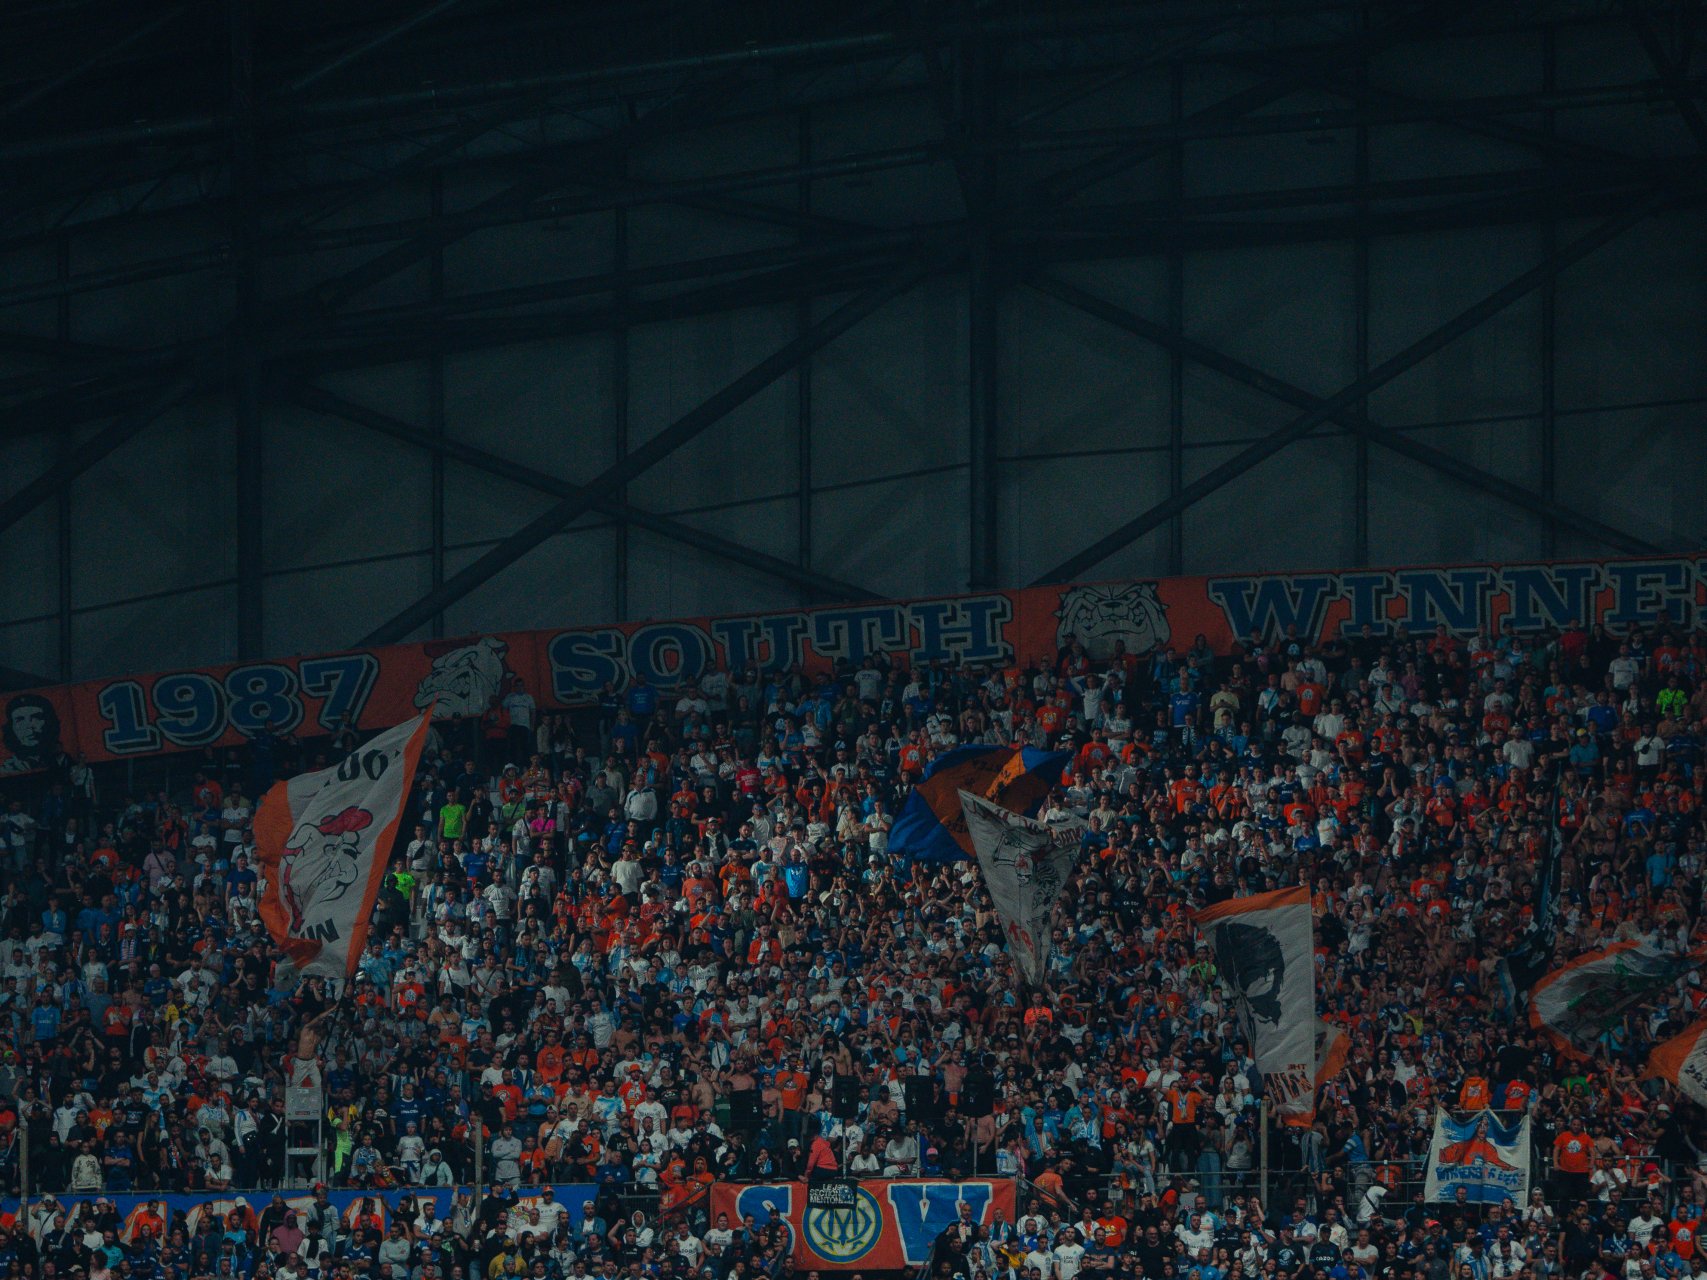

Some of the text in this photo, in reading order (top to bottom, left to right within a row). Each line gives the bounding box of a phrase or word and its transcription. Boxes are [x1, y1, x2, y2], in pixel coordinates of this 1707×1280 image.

[98, 558, 1707, 755] 1987 SOUTH WINNE
